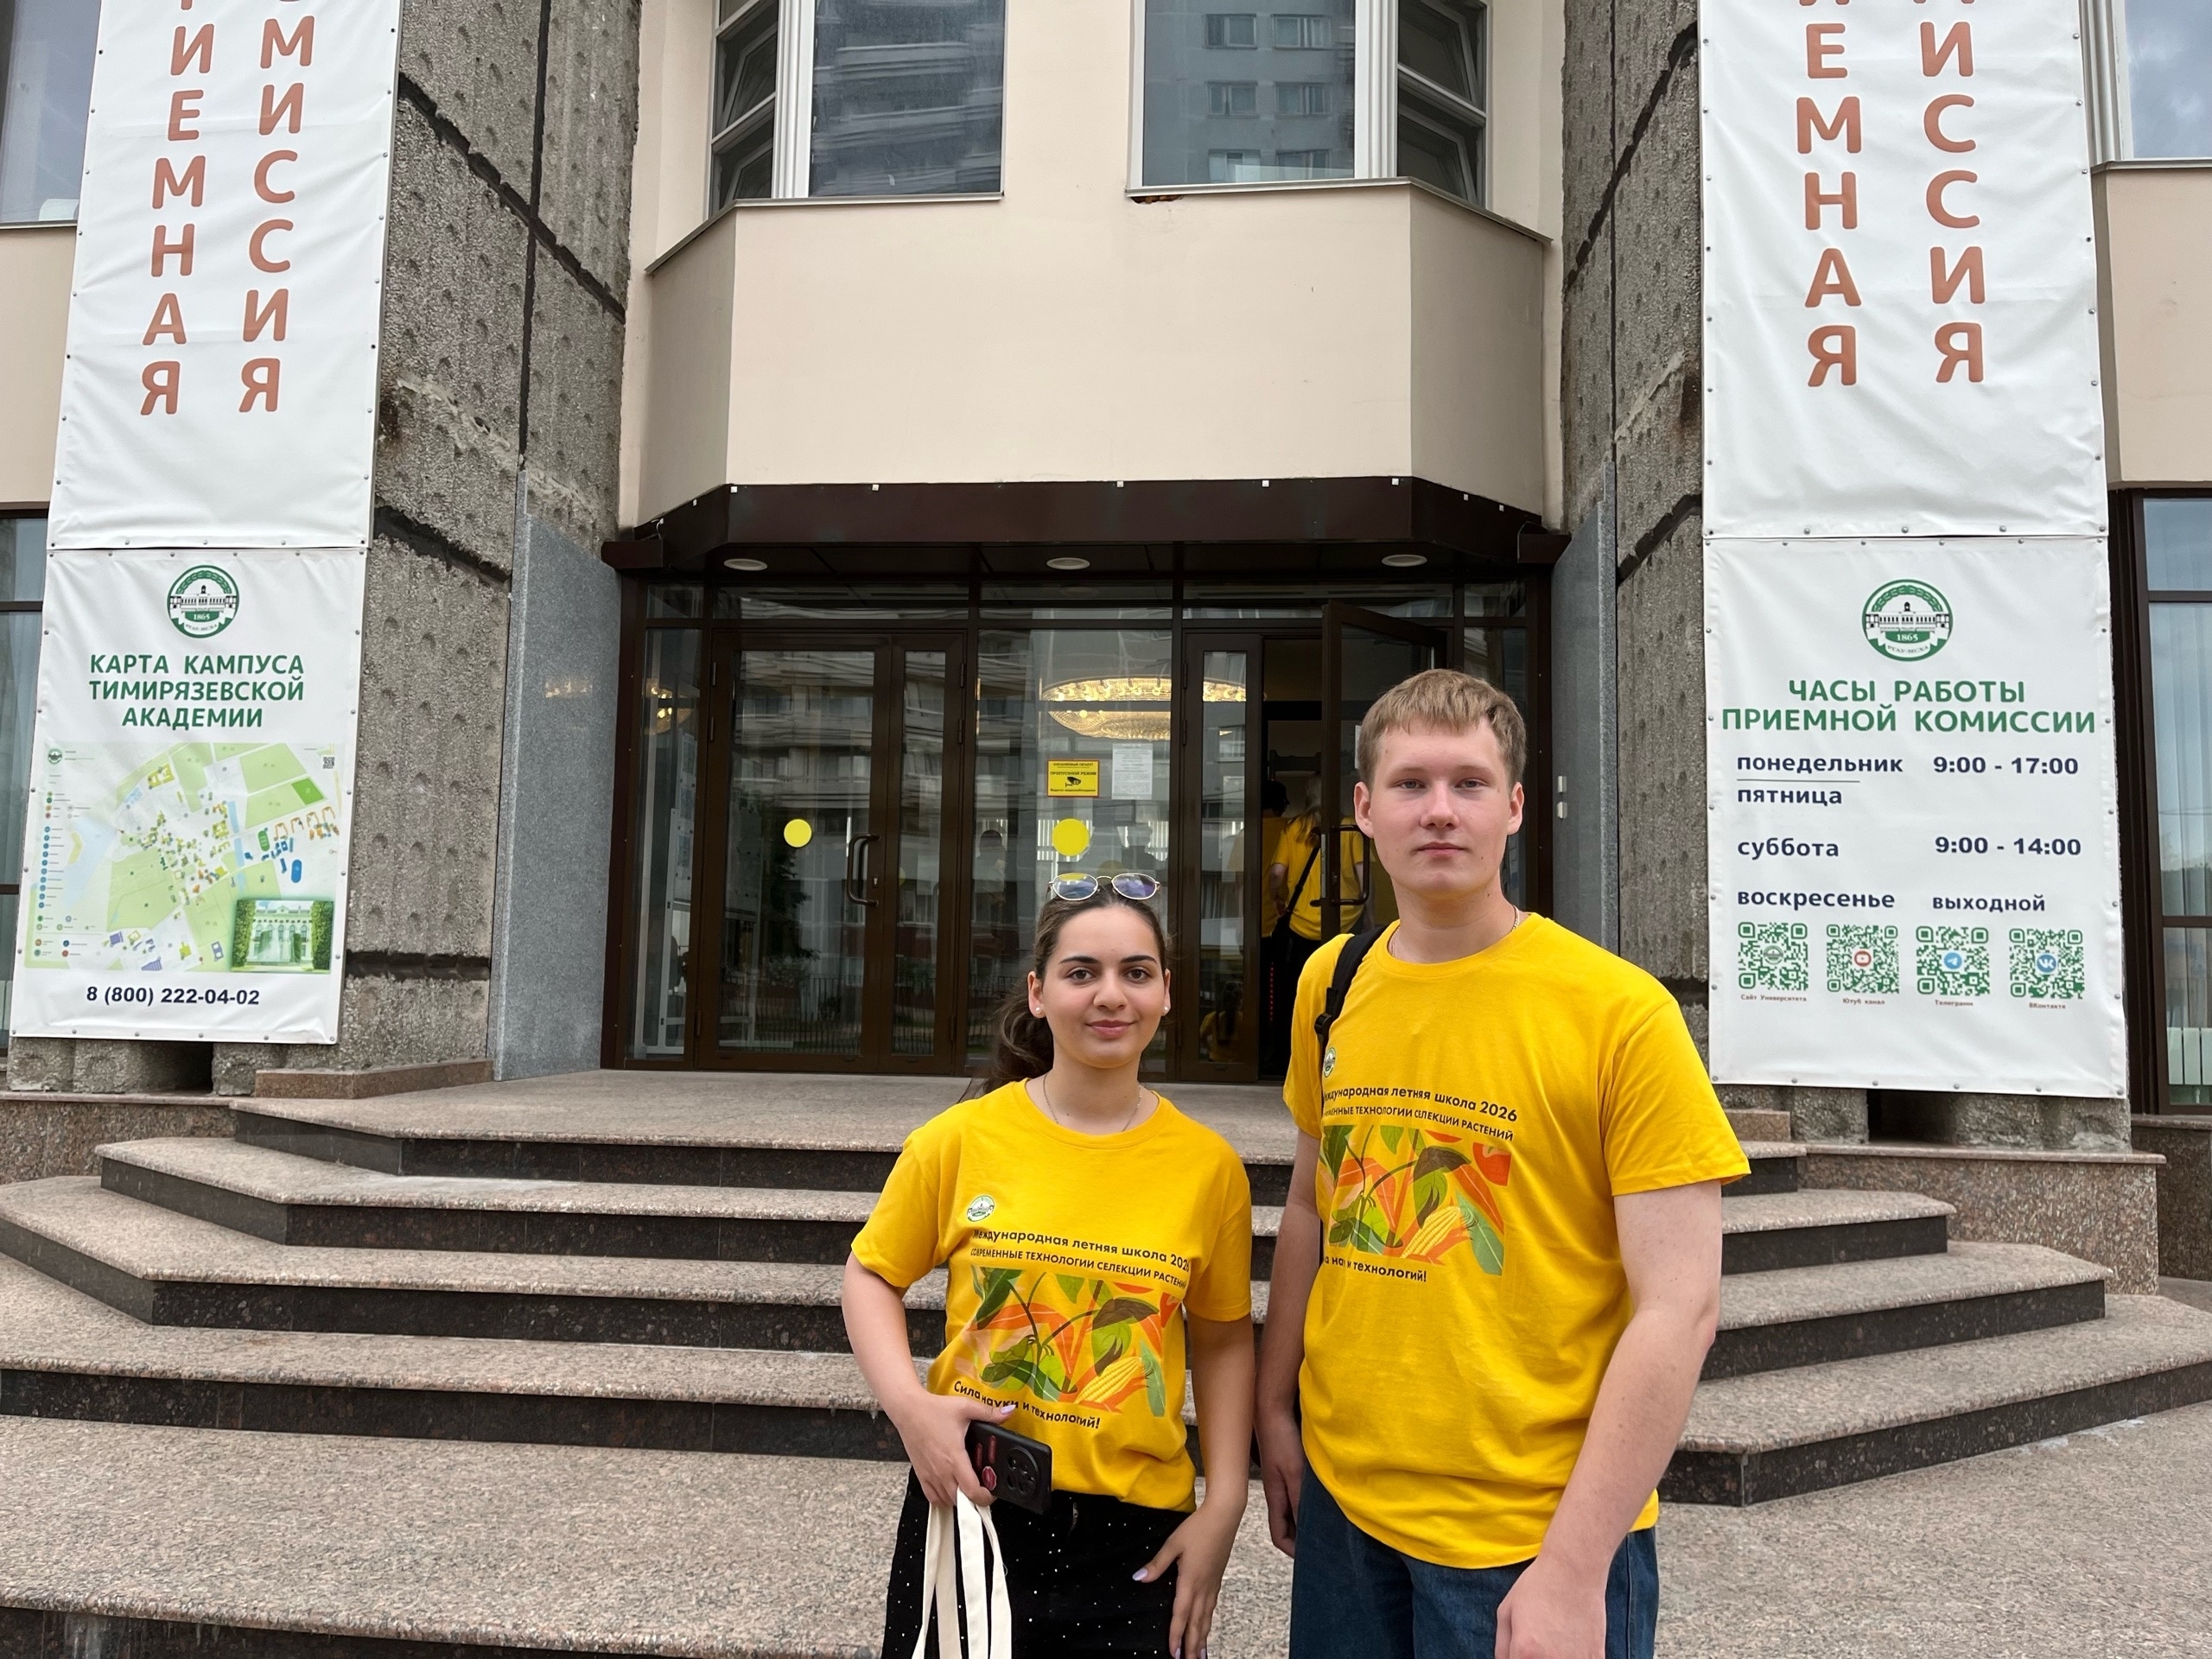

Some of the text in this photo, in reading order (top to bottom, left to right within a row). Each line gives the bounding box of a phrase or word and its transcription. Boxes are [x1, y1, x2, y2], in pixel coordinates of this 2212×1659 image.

[1796, 0, 1862, 387] ЕМНАЯ
[1913, 0, 1986, 383] ИССИЯ
[140, 0, 214, 416] ИЕМНАЯ
[238, 0, 315, 412] МИССИЯ
[91, 654, 304, 674] КАРТА КАМПУСА
[89, 676, 304, 701] ТИМИРЯЗЕВСКОЙ
[1789, 680, 2024, 702] ЧАСЫ РАБОТЫ
[122, 708, 263, 730] АКАДЕМИИ
[1722, 704, 2095, 734] ПРИЕМНОЙ КОМИССИИ
[1738, 756, 1904, 774] понедельник
[1933, 756, 1986, 773] 9:00
[2012, 757, 2079, 774] 17:00
[1738, 789, 1842, 806] пятница
[1738, 837, 1839, 860] суббота
[1935, 836, 1988, 854] 9:00
[2013, 837, 2082, 855] 14:00
[1738, 891, 1895, 911] воскресенье
[1932, 894, 2045, 912] выходной
[86, 986, 260, 1006] 8 (800) 222-04-02
[1760, 994, 1807, 1002] Университета
[1391, 1088, 1431, 1100] летняя
[1434, 1093, 1477, 1111] школа
[1479, 1101, 1517, 1122] 2026
[1414, 1109, 1459, 1127] СЕЛЕКЦИИ
[1461, 1120, 1514, 1141] РАСТЕНИЙ
[1072, 1240, 1118, 1254] летняя
[1122, 1247, 1167, 1262] школа
[970, 1248, 1023, 1259] СОВРЕМЕННЫЕ
[1026, 1251, 1095, 1269] ТЕХНОЛОГИИ
[1096, 1262, 1151, 1278] СЕЛЕКЦИИ
[1353, 1262, 1427, 1282] технологий!
[954, 1381, 981, 1400] Сила
[1022, 1402, 1030, 1411] и
[1032, 1405, 1101, 1429] технологий!
